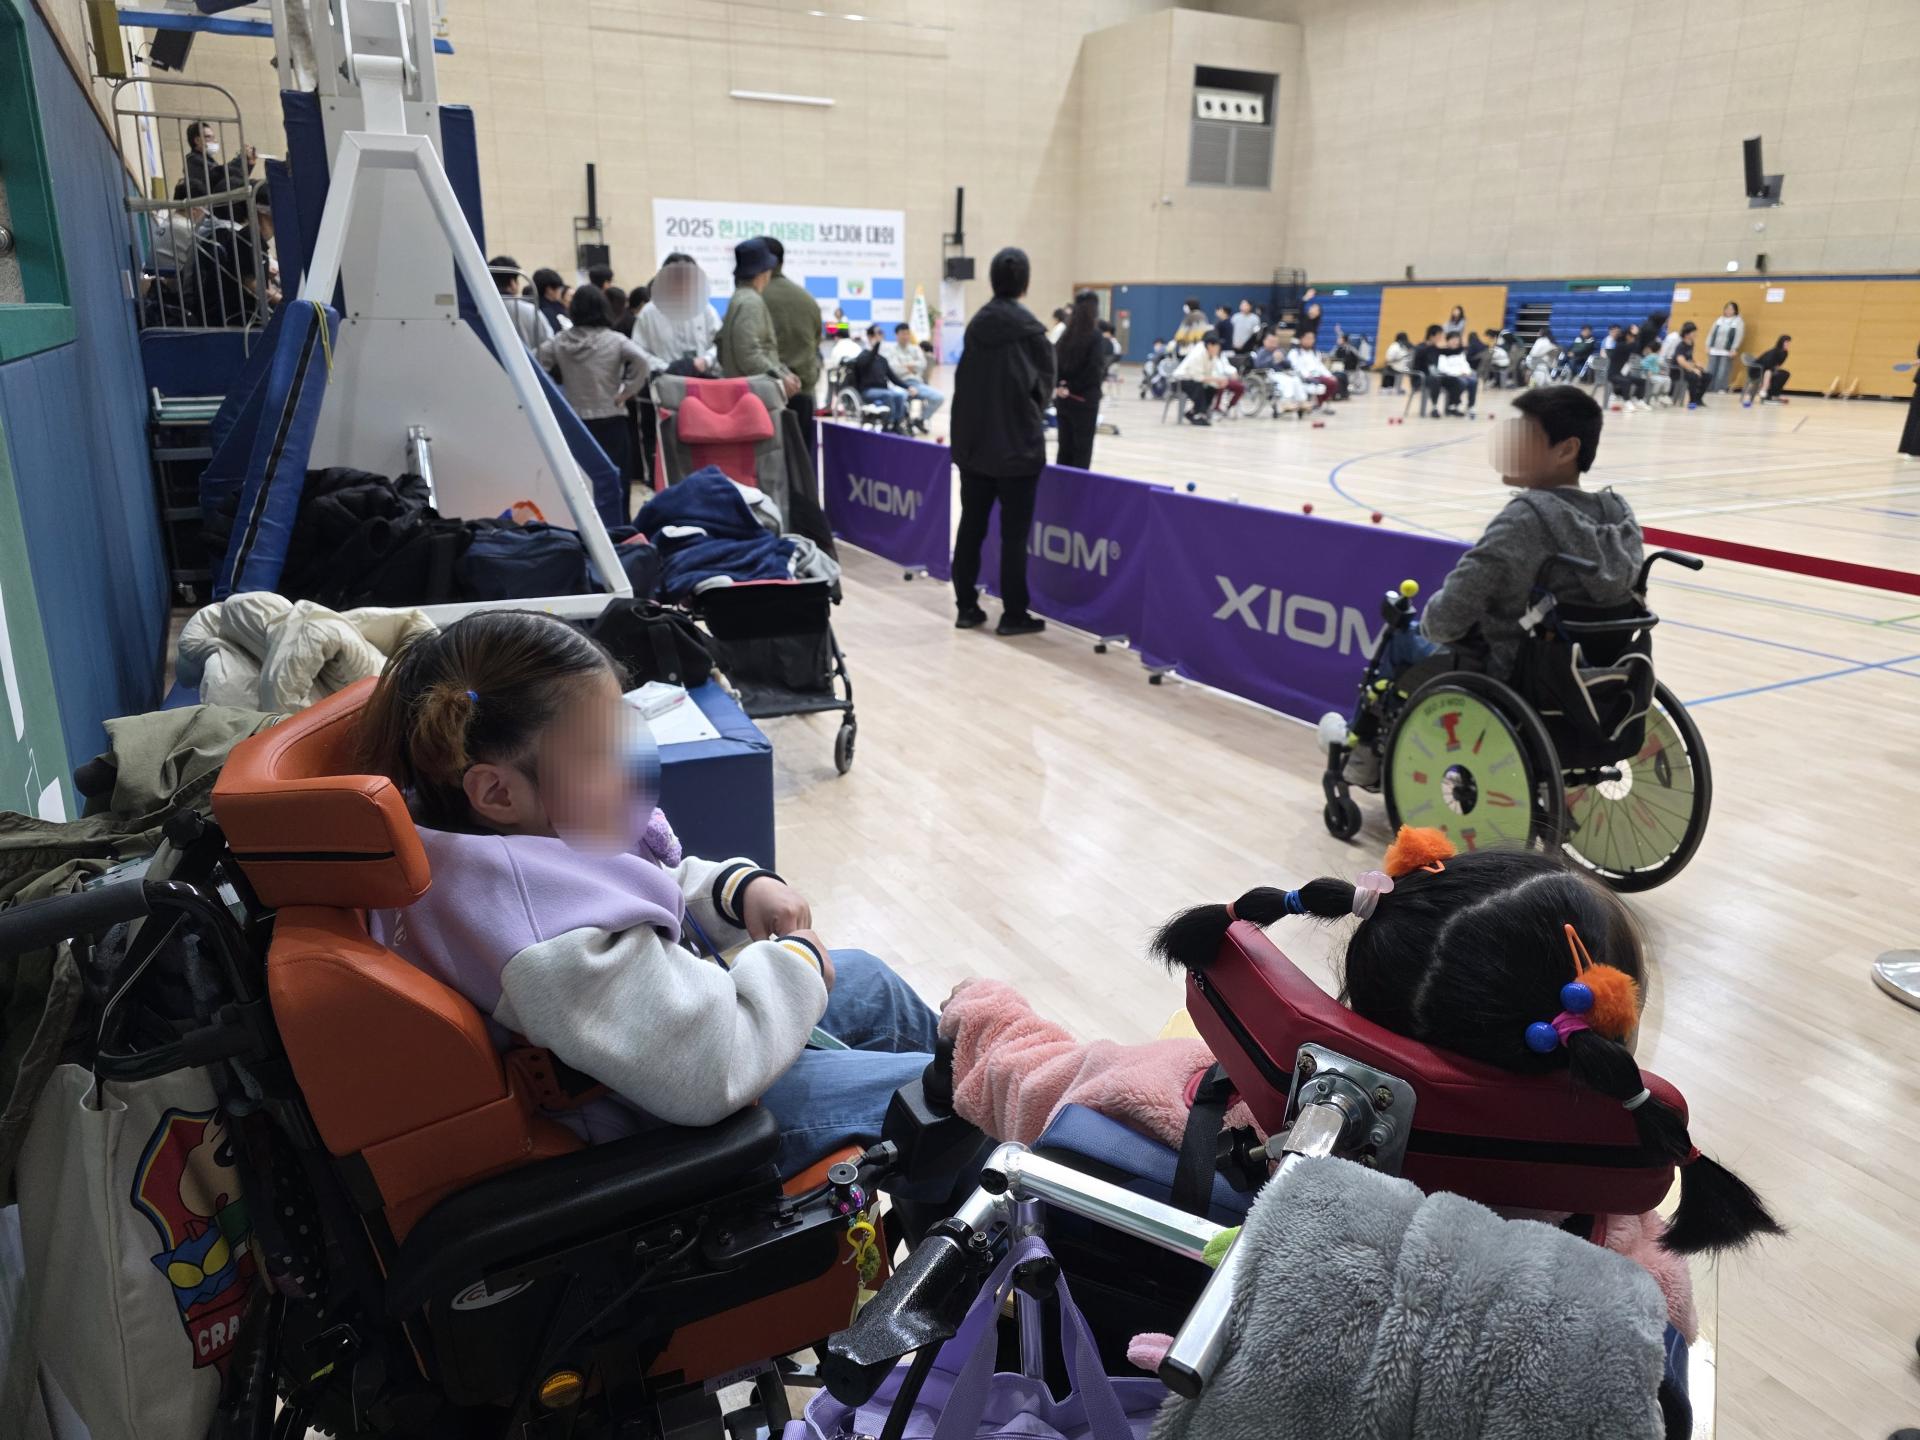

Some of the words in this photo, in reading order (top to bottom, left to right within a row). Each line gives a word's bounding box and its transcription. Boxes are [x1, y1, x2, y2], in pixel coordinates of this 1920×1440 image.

[665, 217, 714, 238] 2025
[866, 225, 895, 244] 대회
[1212, 574, 1389, 661] XIOM
[198, 1313, 242, 1356] CRA
